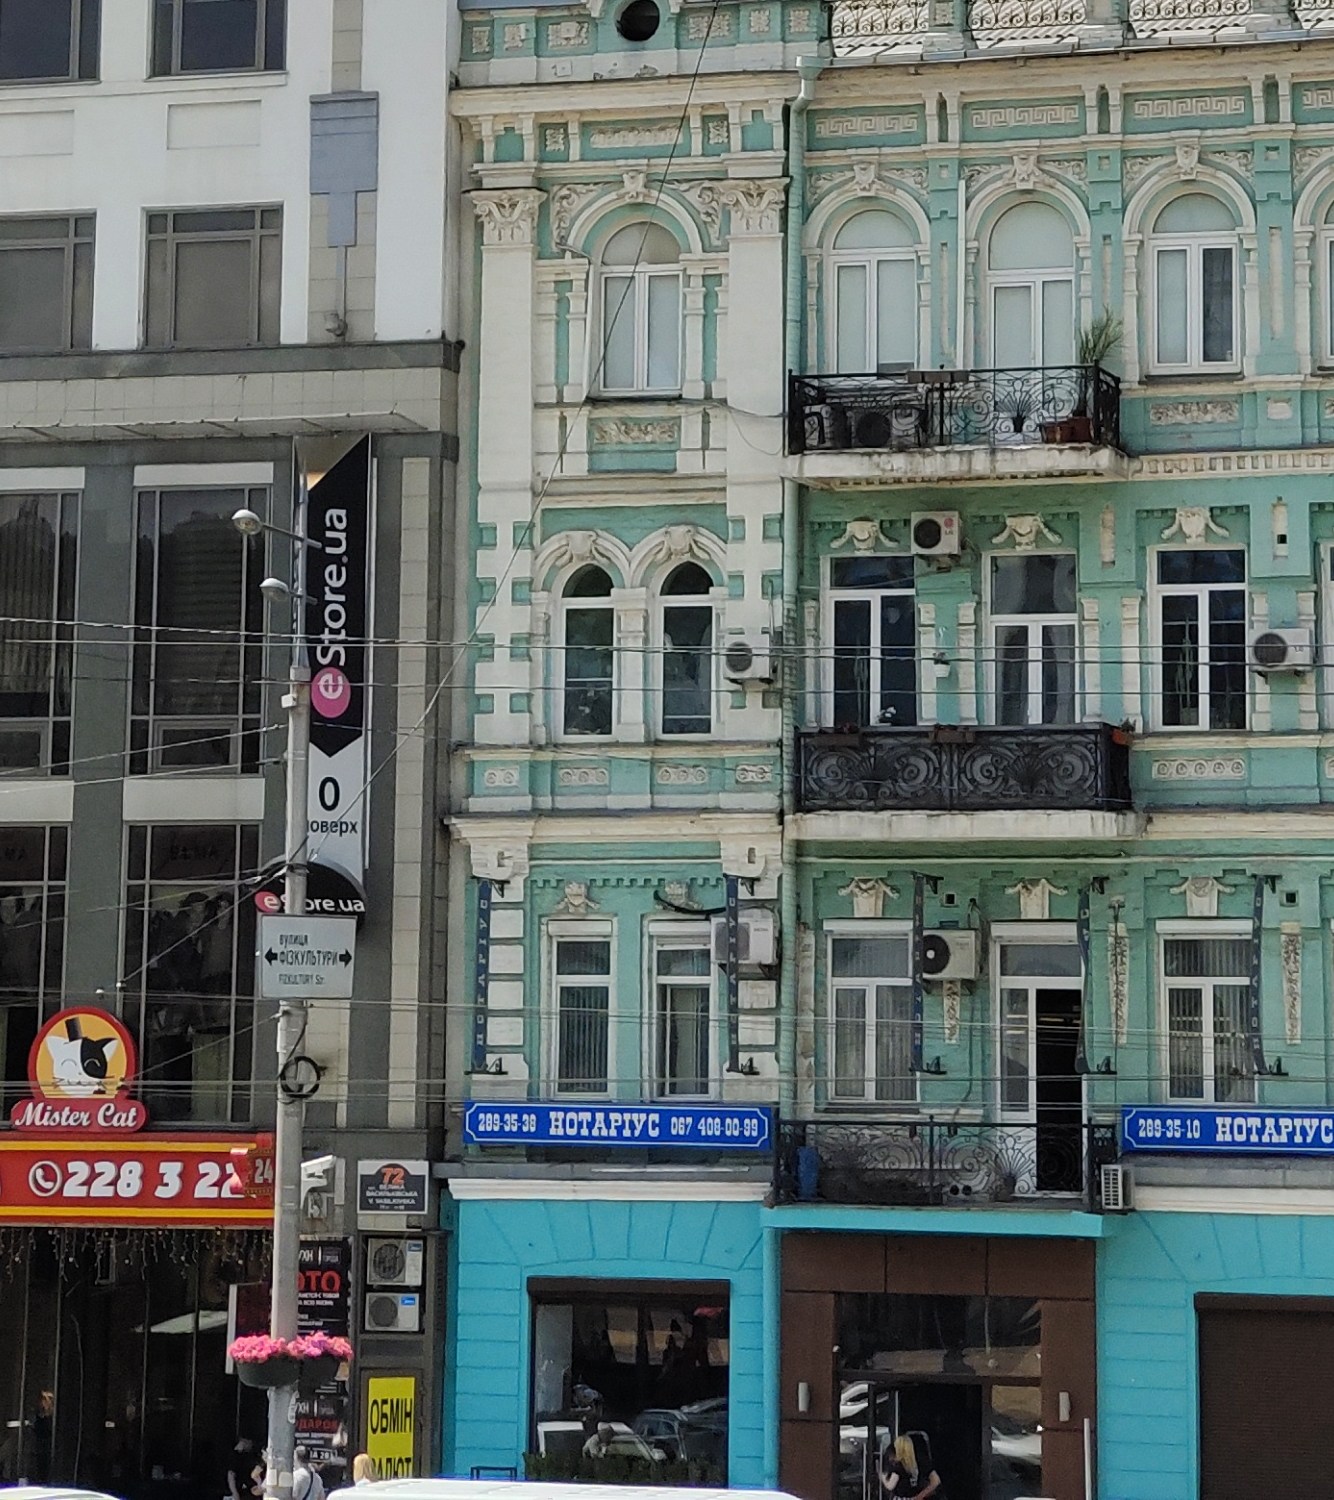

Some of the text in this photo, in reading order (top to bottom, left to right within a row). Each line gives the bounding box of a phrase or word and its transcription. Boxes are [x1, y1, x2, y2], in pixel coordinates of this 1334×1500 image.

[316, 509, 348, 699] eStore.ua
[307, 820, 358, 835] оверх
[263, 895, 365, 912] eore.ua
[279, 934, 308, 948] вулиця
[279, 950, 338, 966] ФІЗКУЛЬТУРИ
[15, 1101, 137, 1128] Mister Cat
[549, 1112, 660, 1137] НОТАРІУС
[671, 1116, 693, 1135] 067
[1139, 1118, 1200, 1139] 289-35-10
[1216, 1117, 1333, 1143] НОТАРІУС
[63, 1161, 144, 1197] 228
[154, 1161, 183, 1198] 3
[381, 1167, 405, 1186] 72
[370, 1398, 412, 1434] ОБМІН
[372, 1457, 412, 1479] АЛЮТ
